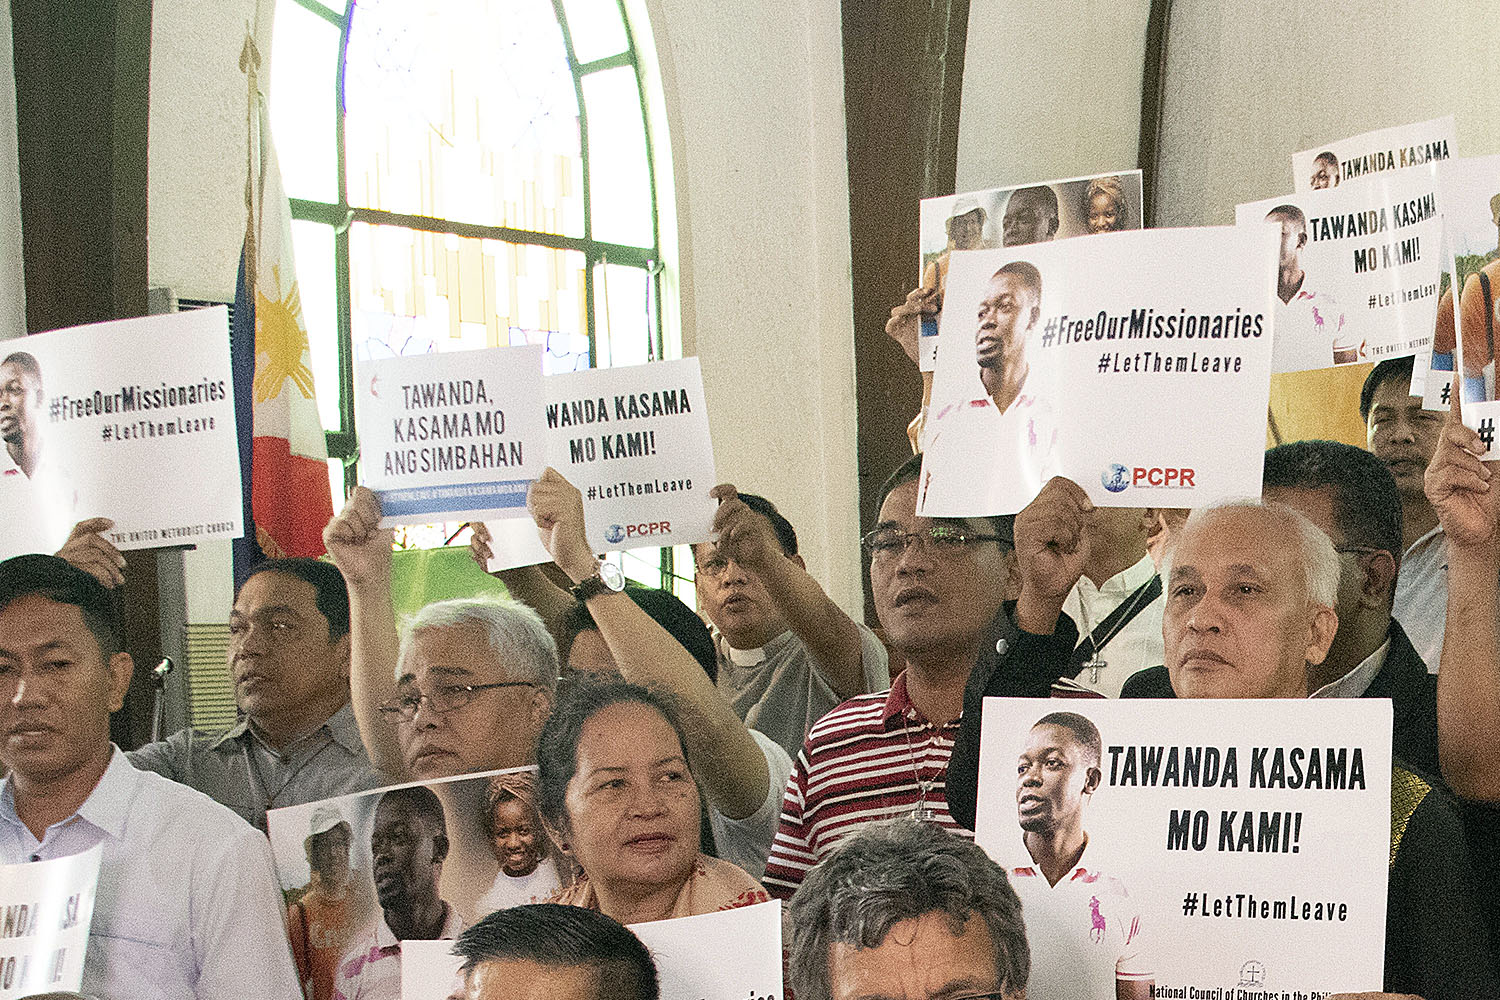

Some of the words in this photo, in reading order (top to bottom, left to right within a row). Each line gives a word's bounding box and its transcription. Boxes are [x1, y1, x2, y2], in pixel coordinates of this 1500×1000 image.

[1341, 150, 1395, 181] TAWANDA
[1400, 139, 1450, 169] KASAMA
[1310, 207, 1388, 242] TAWANDA
[1392, 192, 1437, 229] KASAMA
[1354, 247, 1378, 274] MO
[1042, 308, 1264, 348] #FreeOurMissionaries
[1098, 351, 1242, 374] #LetThemLeave
[50, 378, 226, 422] #FreeOurMissionaries
[614, 388, 692, 421] KASAMA
[102, 415, 216, 442] #LetThemLeave
[569, 437, 596, 464] MO
[602, 430, 656, 460] KAMI!
[587, 478, 693, 501] #LetThemLeave
[1133, 467, 1195, 487] PCPR
[626, 520, 672, 537] PCPR
[1108, 745, 1238, 789] TAWANDA
[1249, 747, 1366, 790] KASAMA
[1167, 809, 1209, 851] MO
[1218, 811, 1303, 854] KAMI!
[1182, 892, 1348, 922] #LetThemLeave
[1149, 984, 1187, 999] National
[1189, 986, 1223, 1000] Council
[1225, 988, 1235, 1000] of
